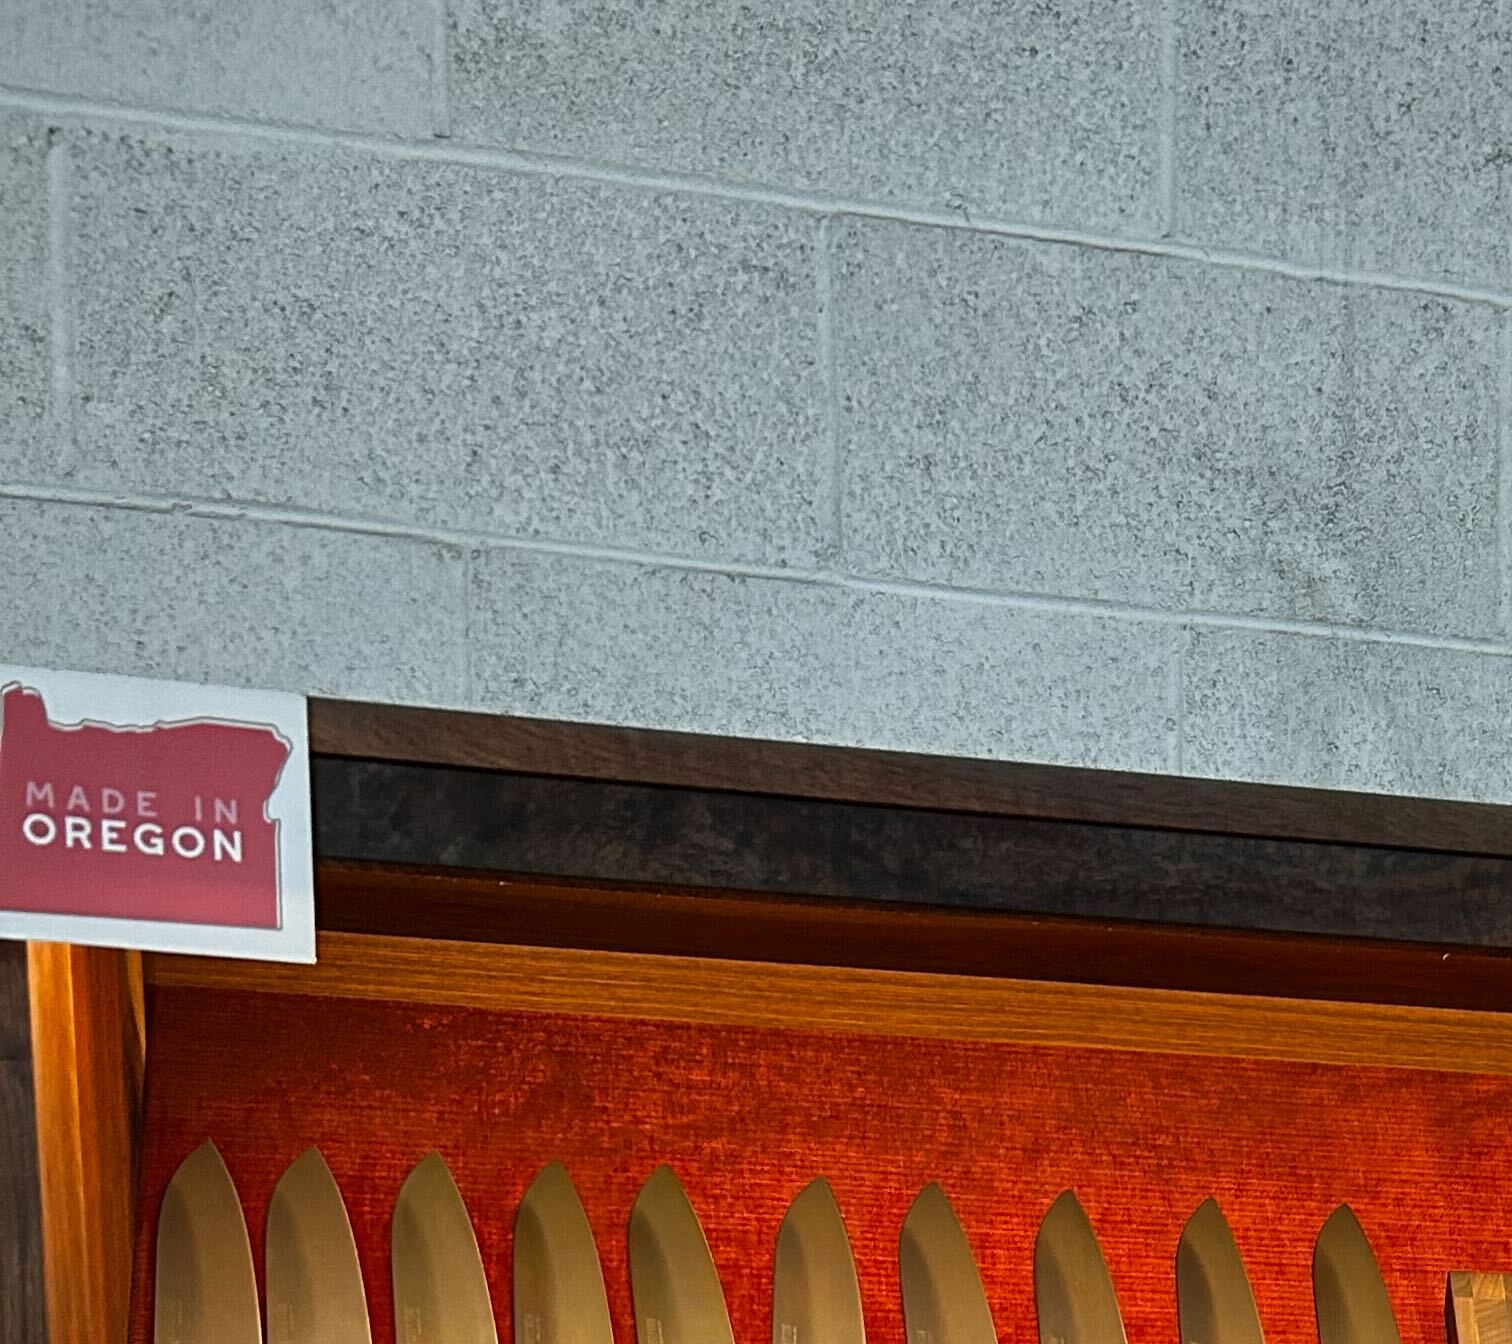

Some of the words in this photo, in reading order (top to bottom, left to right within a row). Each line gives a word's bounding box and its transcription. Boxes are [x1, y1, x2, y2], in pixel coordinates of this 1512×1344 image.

[26, 781, 157, 817] MADE
[194, 795, 237, 824] IN
[22, 813, 242, 863] OREGON
